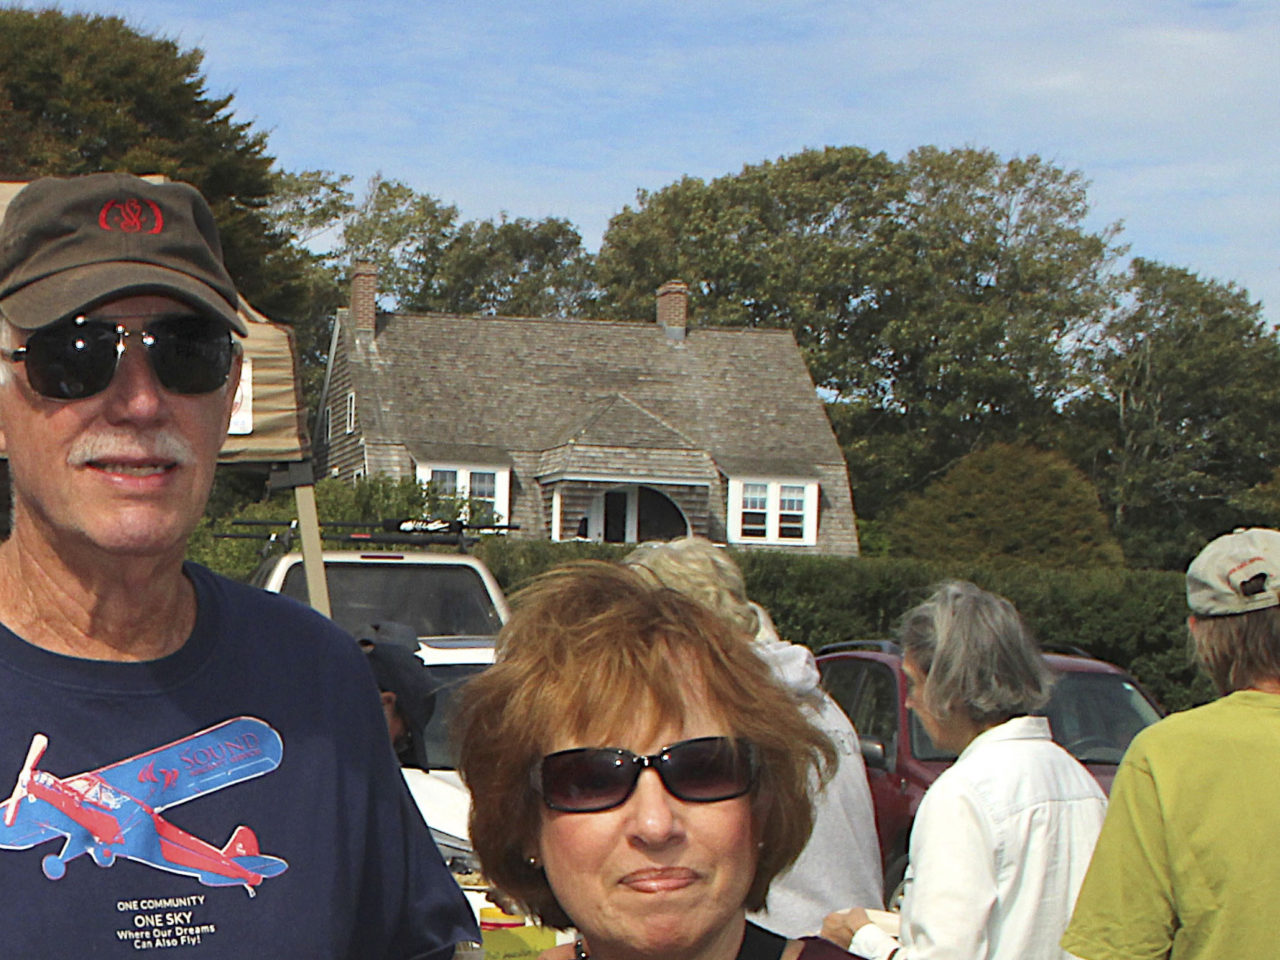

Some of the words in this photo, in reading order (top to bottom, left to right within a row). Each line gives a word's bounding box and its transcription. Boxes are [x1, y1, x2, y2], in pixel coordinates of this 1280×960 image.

[180, 732, 260, 769] SOUND
[117, 901, 139, 911] ONE
[140, 895, 205, 909] COMMUNITY
[134, 914, 163, 927] ONE
[165, 911, 193, 925] SKY
[116, 930, 151, 940] Where
[152, 928, 172, 938] Our
[175, 924, 216, 936] Dreams
[134, 940, 153, 949] Can
[155, 938, 178, 948] Also
[180, 935, 201, 946] Fly!
